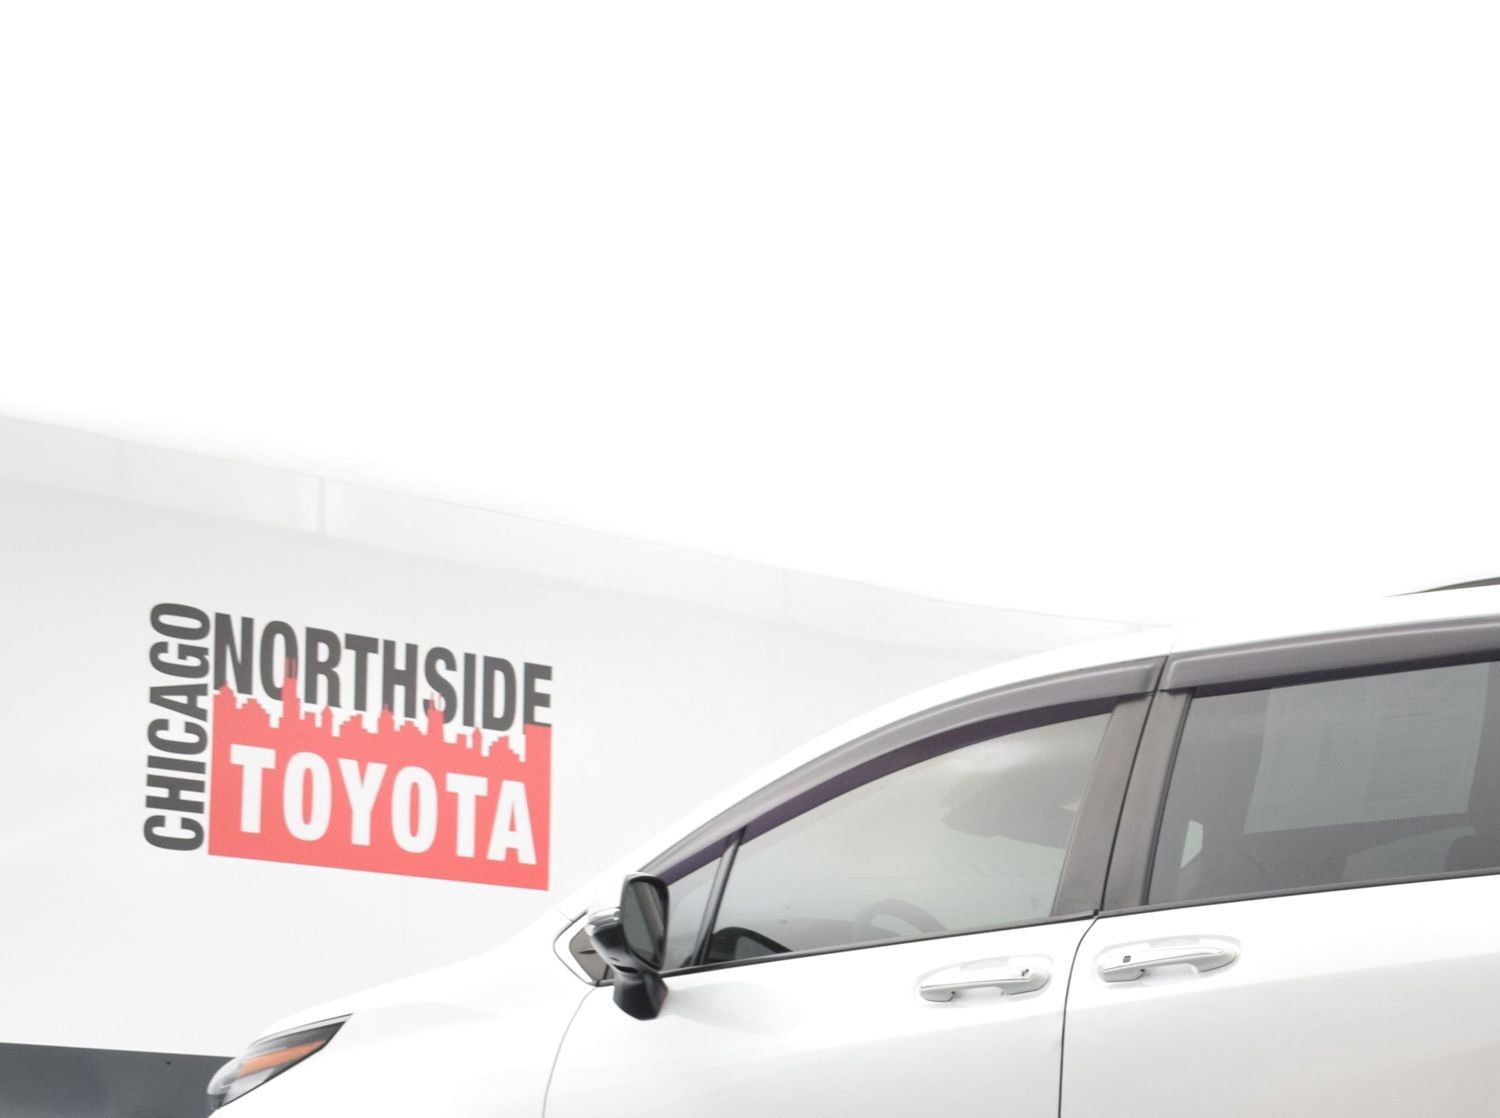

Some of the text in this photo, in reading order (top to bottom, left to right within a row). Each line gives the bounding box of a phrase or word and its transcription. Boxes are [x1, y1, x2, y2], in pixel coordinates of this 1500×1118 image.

[144, 603, 211, 851] CHICAGO
[213, 612, 553, 733] NORTHSIDE
[230, 743, 537, 865] TOYOTA
